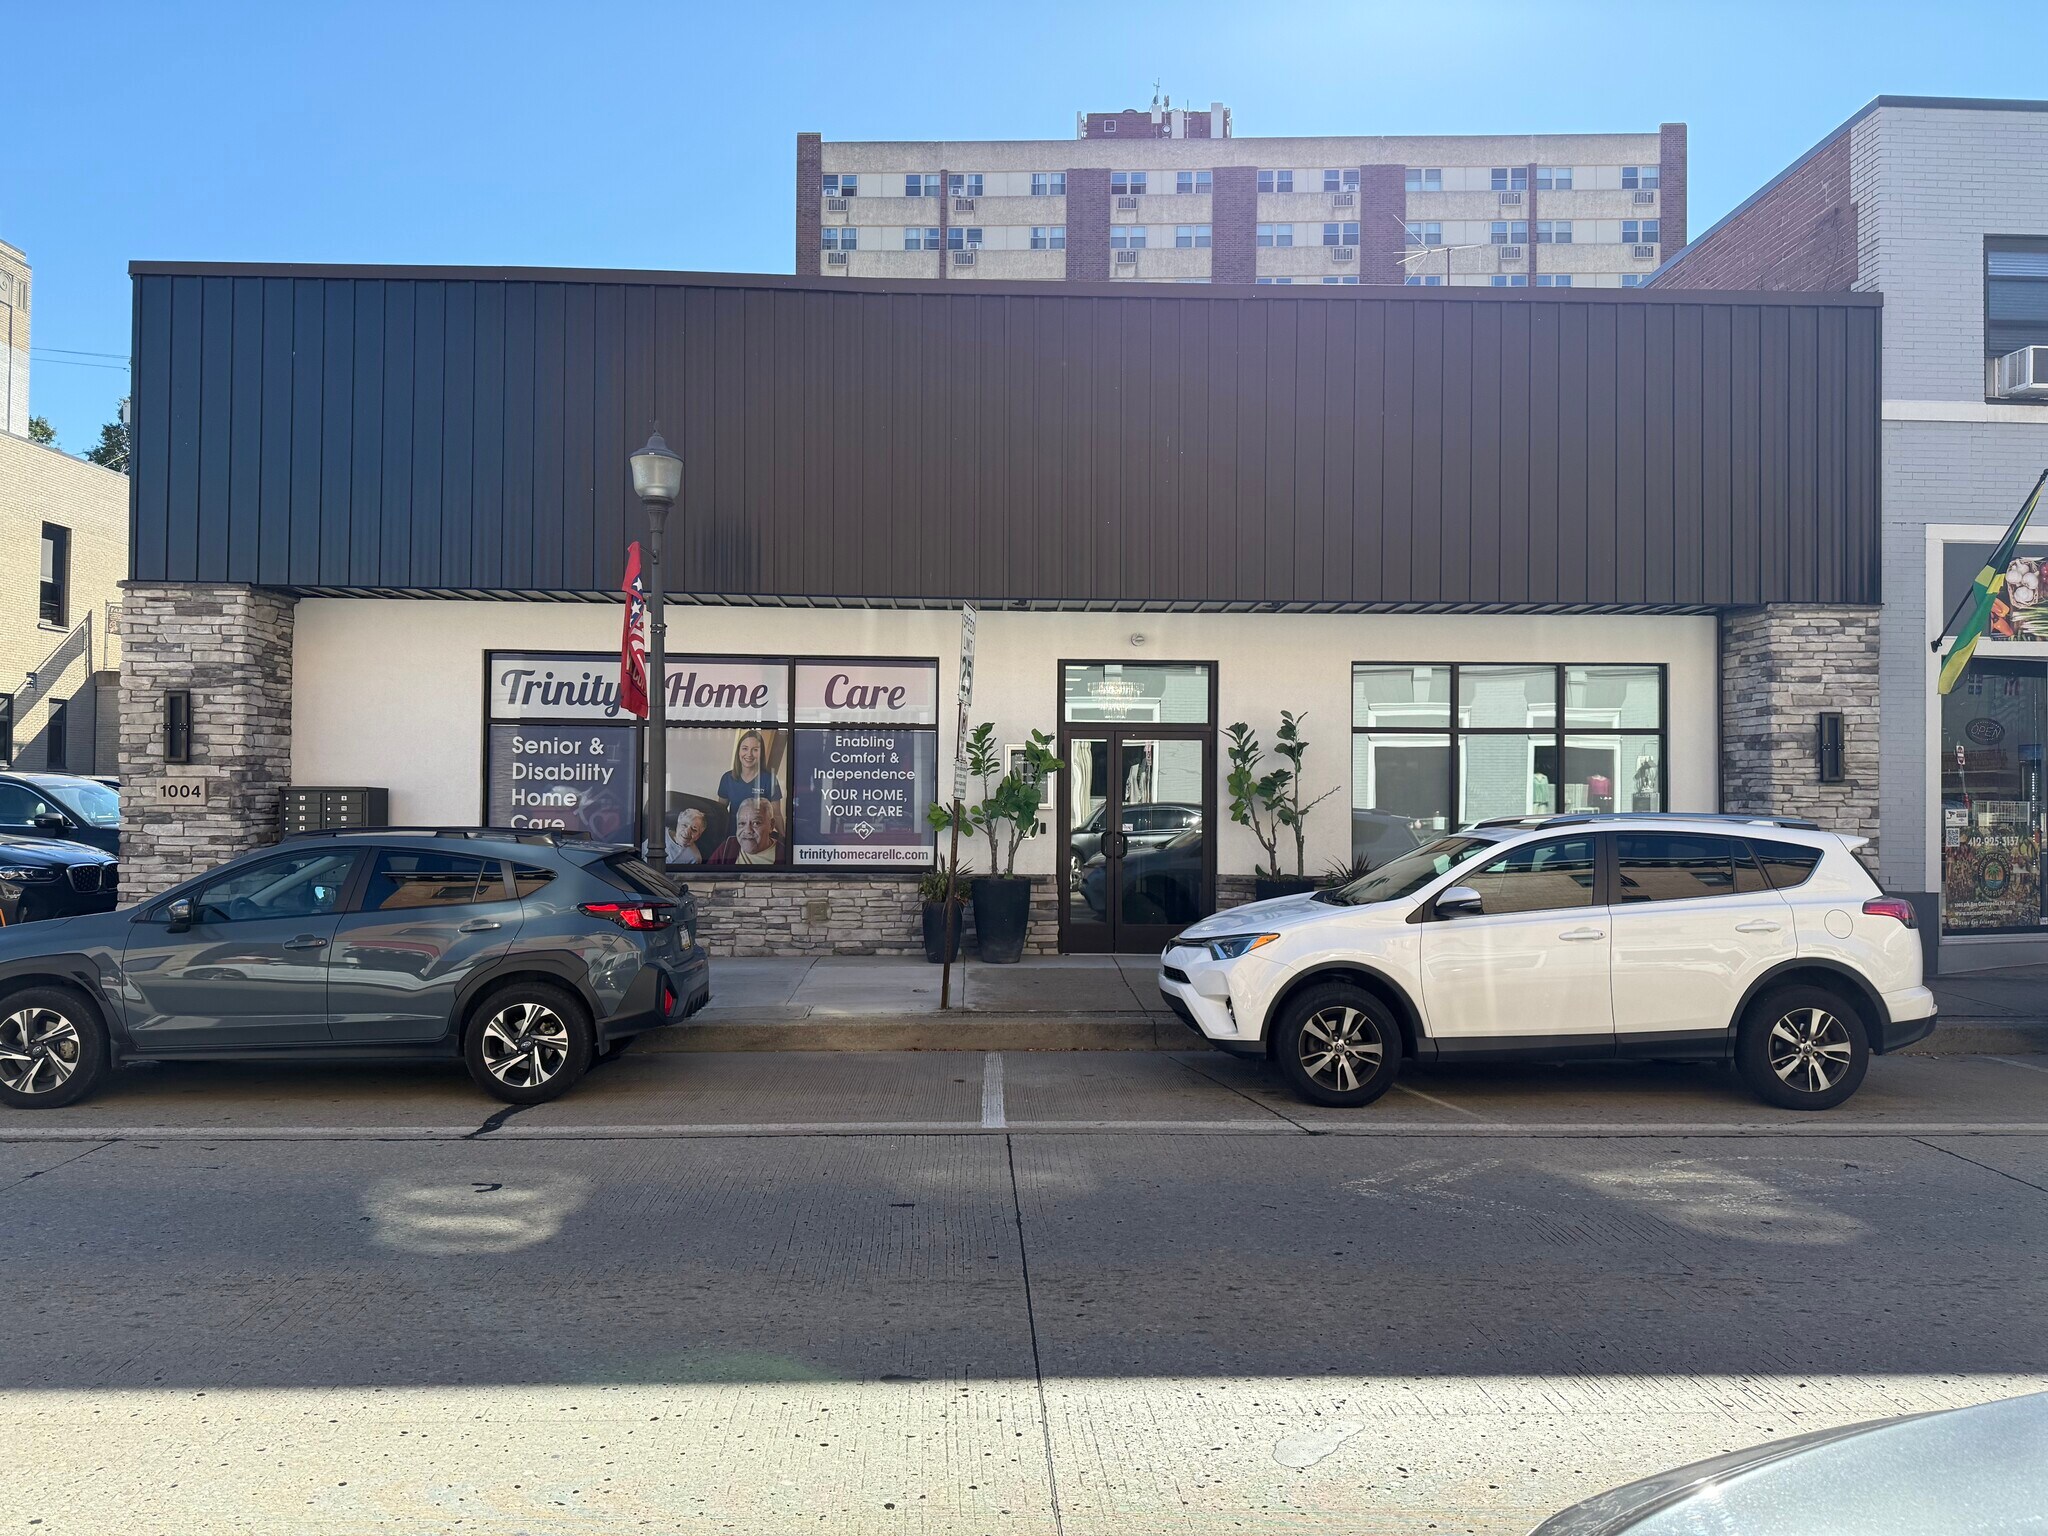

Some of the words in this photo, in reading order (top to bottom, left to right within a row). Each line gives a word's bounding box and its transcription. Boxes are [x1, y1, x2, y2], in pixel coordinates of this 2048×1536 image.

[961, 656, 972, 695] 25
[501, 669, 622, 717] Trinity
[665, 672, 769, 708] Home
[824, 673, 906, 710] Care
[1971, 724, 2001, 738] OPEN
[511, 736, 582, 754] Senior
[589, 737, 604, 755] &
[835, 735, 895, 750] Enabling
[830, 752, 886, 763] Comfort
[890, 752, 900, 763] &
[511, 762, 614, 784] Disability
[814, 768, 916, 781] Independence
[160, 785, 202, 798] 1004
[511, 788, 577, 806] Home
[821, 789, 858, 800] YOUR
[862, 789, 908, 802] HOME,
[826, 805, 862, 817] YOUR
[866, 805, 903, 817] CARE
[510, 814, 566, 830] Care
[799, 848, 929, 862] trinityhomecarellc.com
